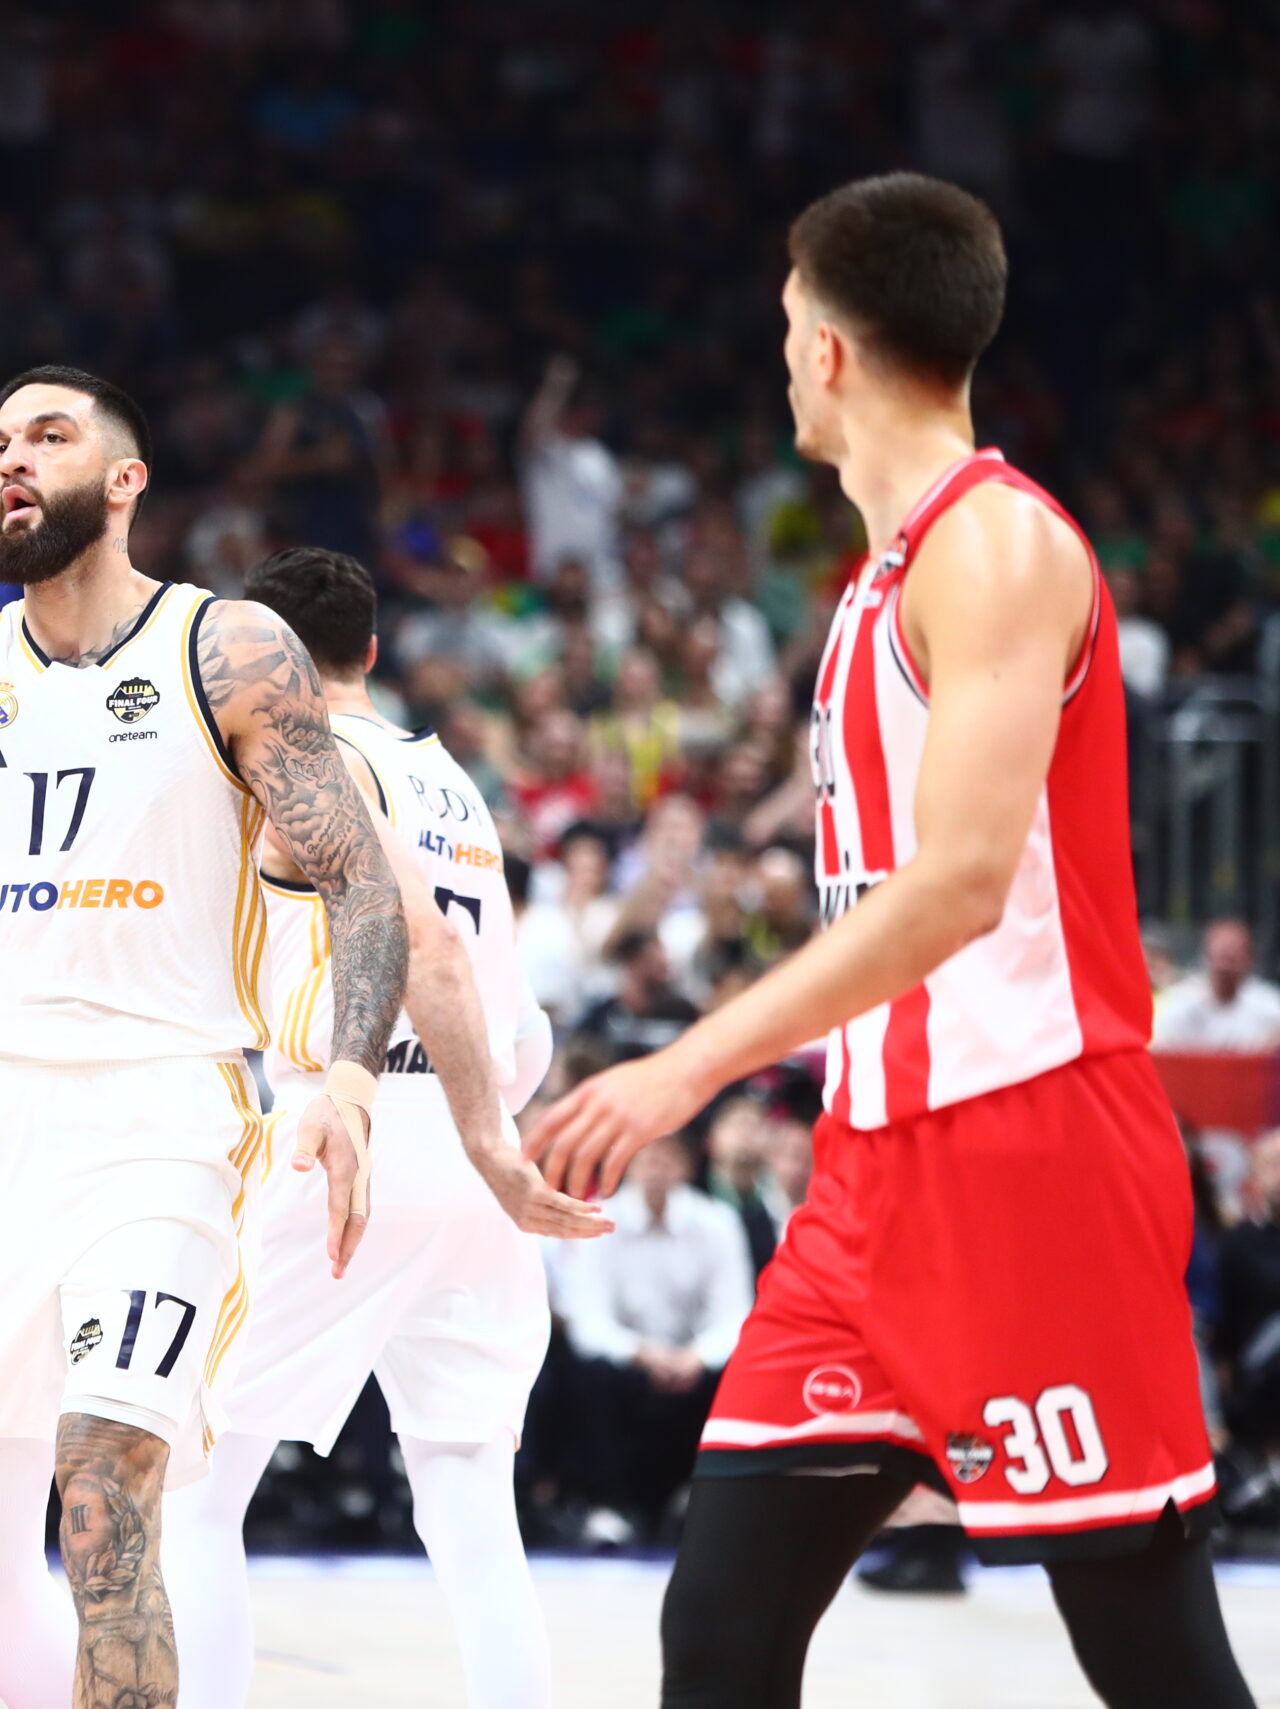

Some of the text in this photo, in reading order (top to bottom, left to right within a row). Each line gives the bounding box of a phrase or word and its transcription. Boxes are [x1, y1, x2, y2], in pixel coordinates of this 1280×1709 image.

[108, 731, 158, 743] oneteam
[109, 695, 157, 707] FINAL FOUR
[23, 767, 96, 855] 17
[115, 1290, 197, 1378] 17
[983, 1384, 1108, 1494] 30
